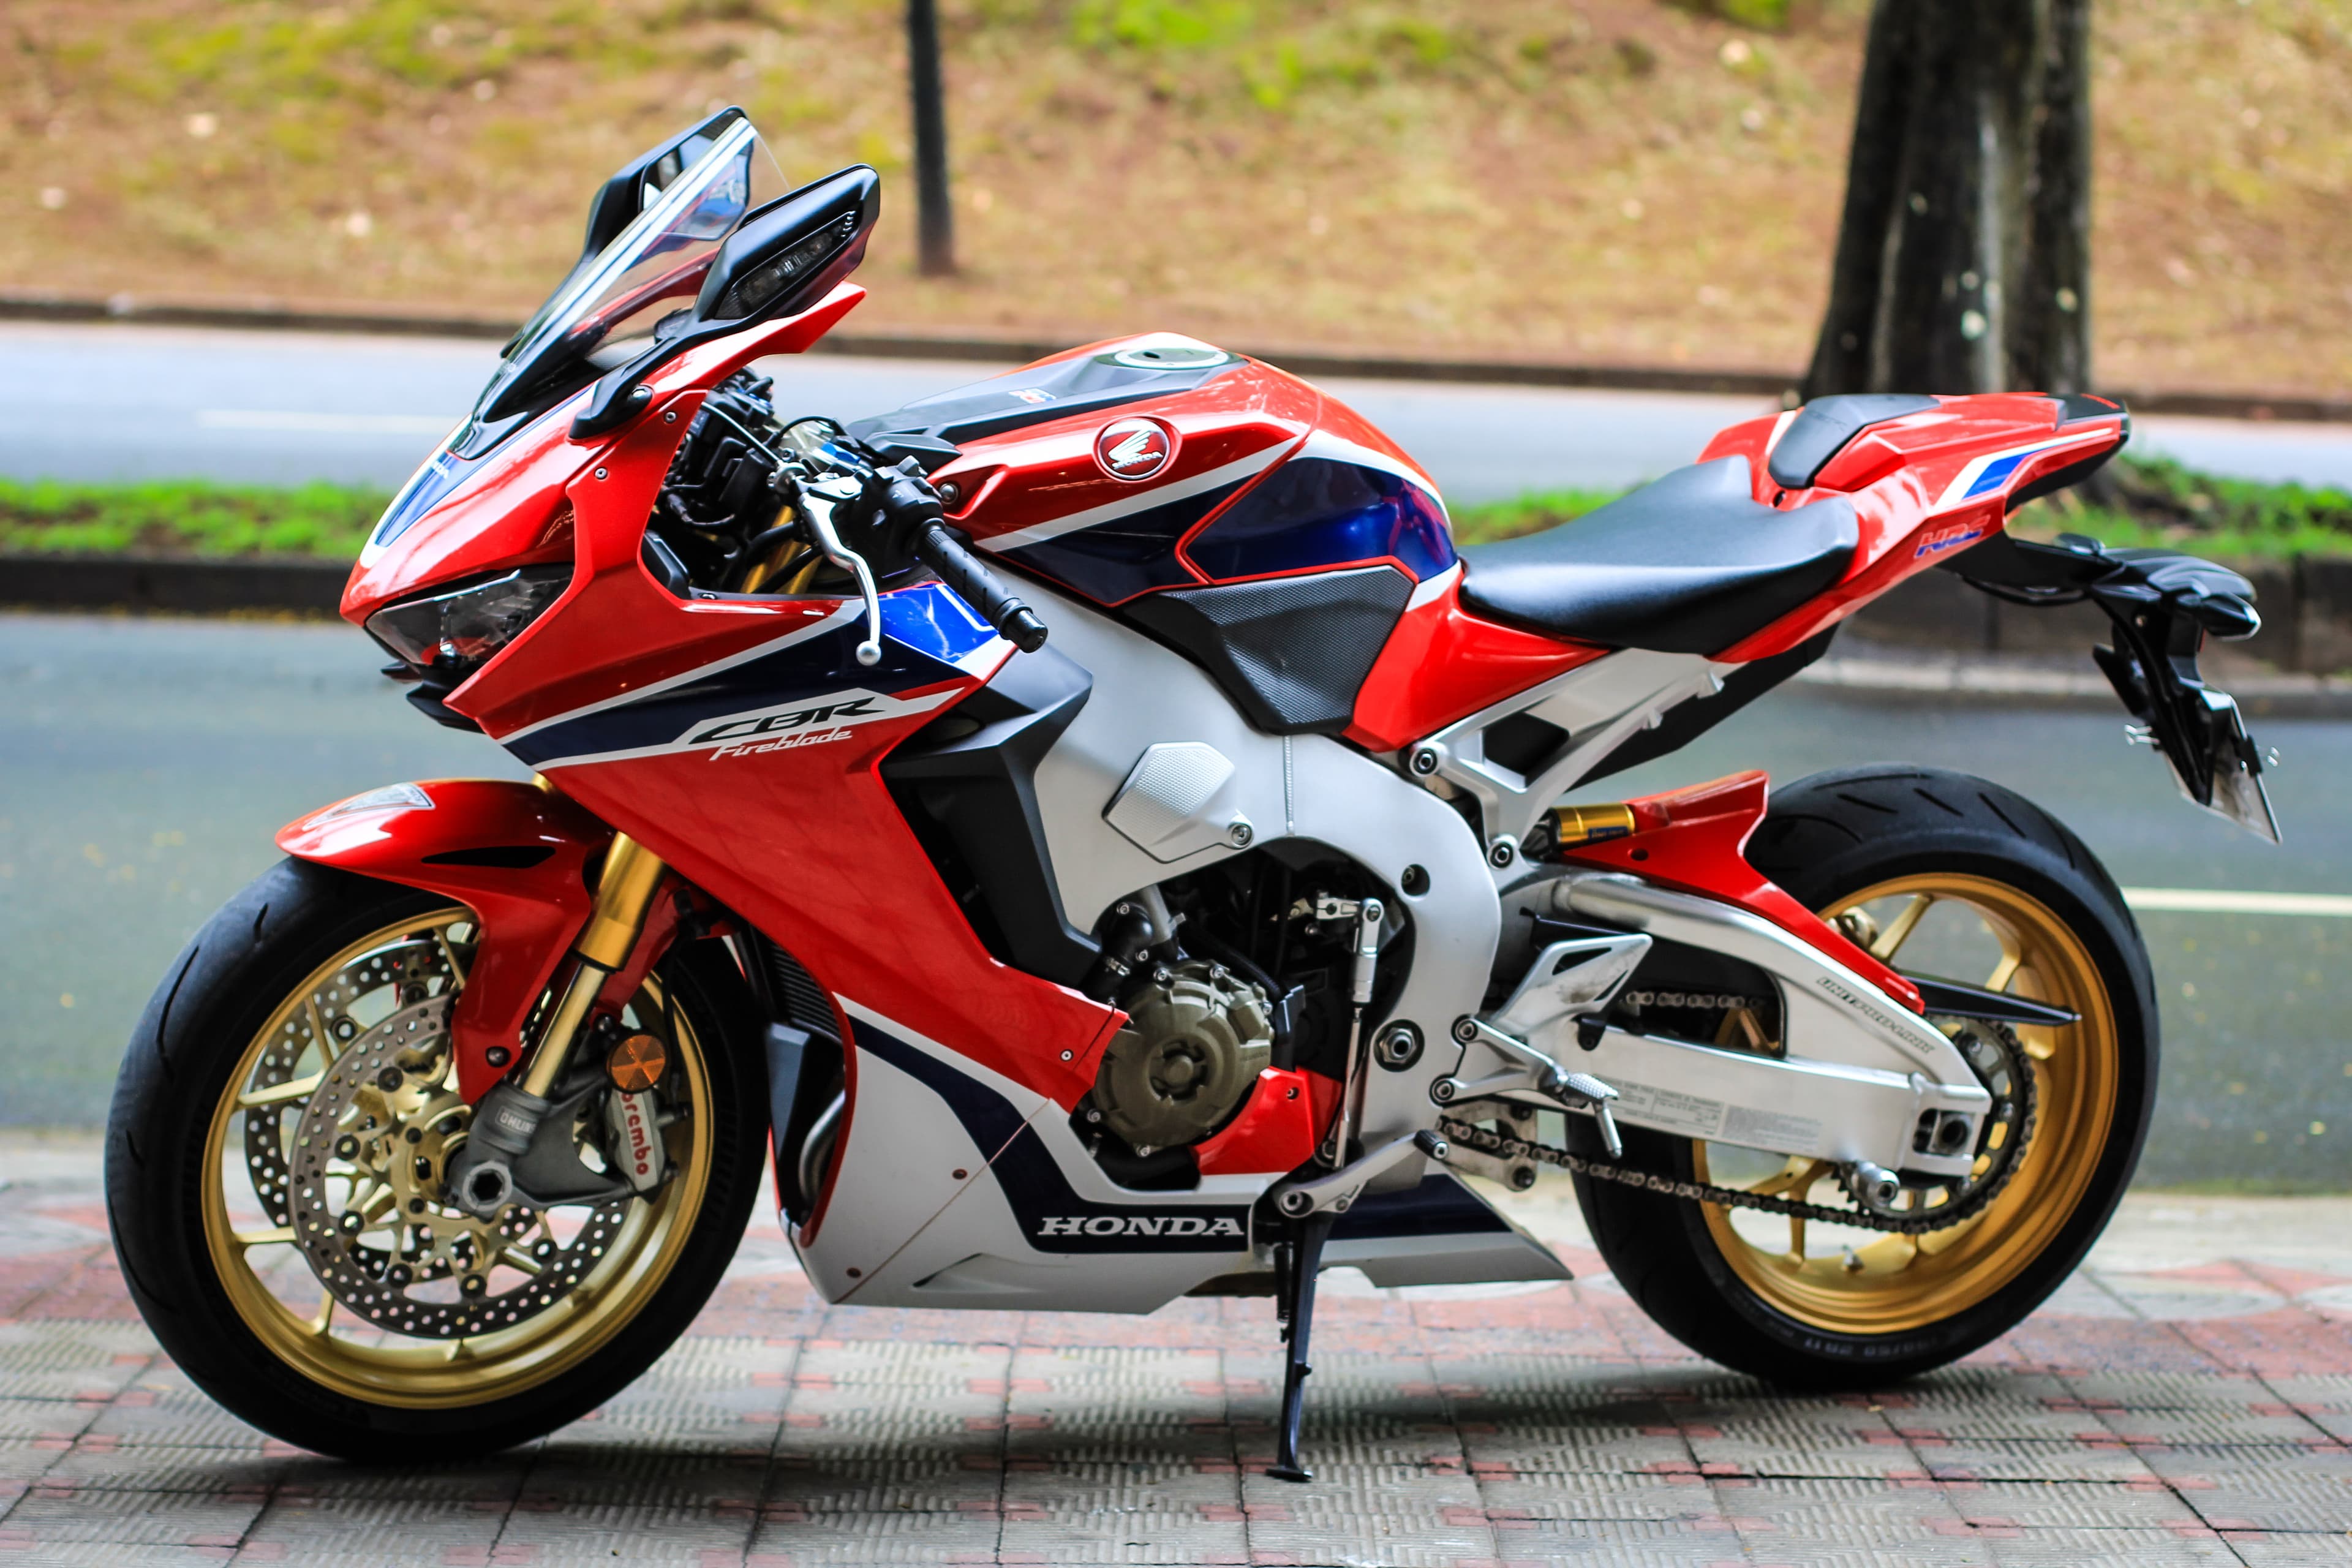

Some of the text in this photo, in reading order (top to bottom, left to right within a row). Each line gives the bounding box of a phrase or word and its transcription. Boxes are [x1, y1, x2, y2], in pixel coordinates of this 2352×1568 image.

[1913, 514, 1991, 559] HRC
[688, 696, 886, 744] CBR
[709, 726, 853, 761] Fireblade
[1037, 1216, 1245, 1235] HONDA
